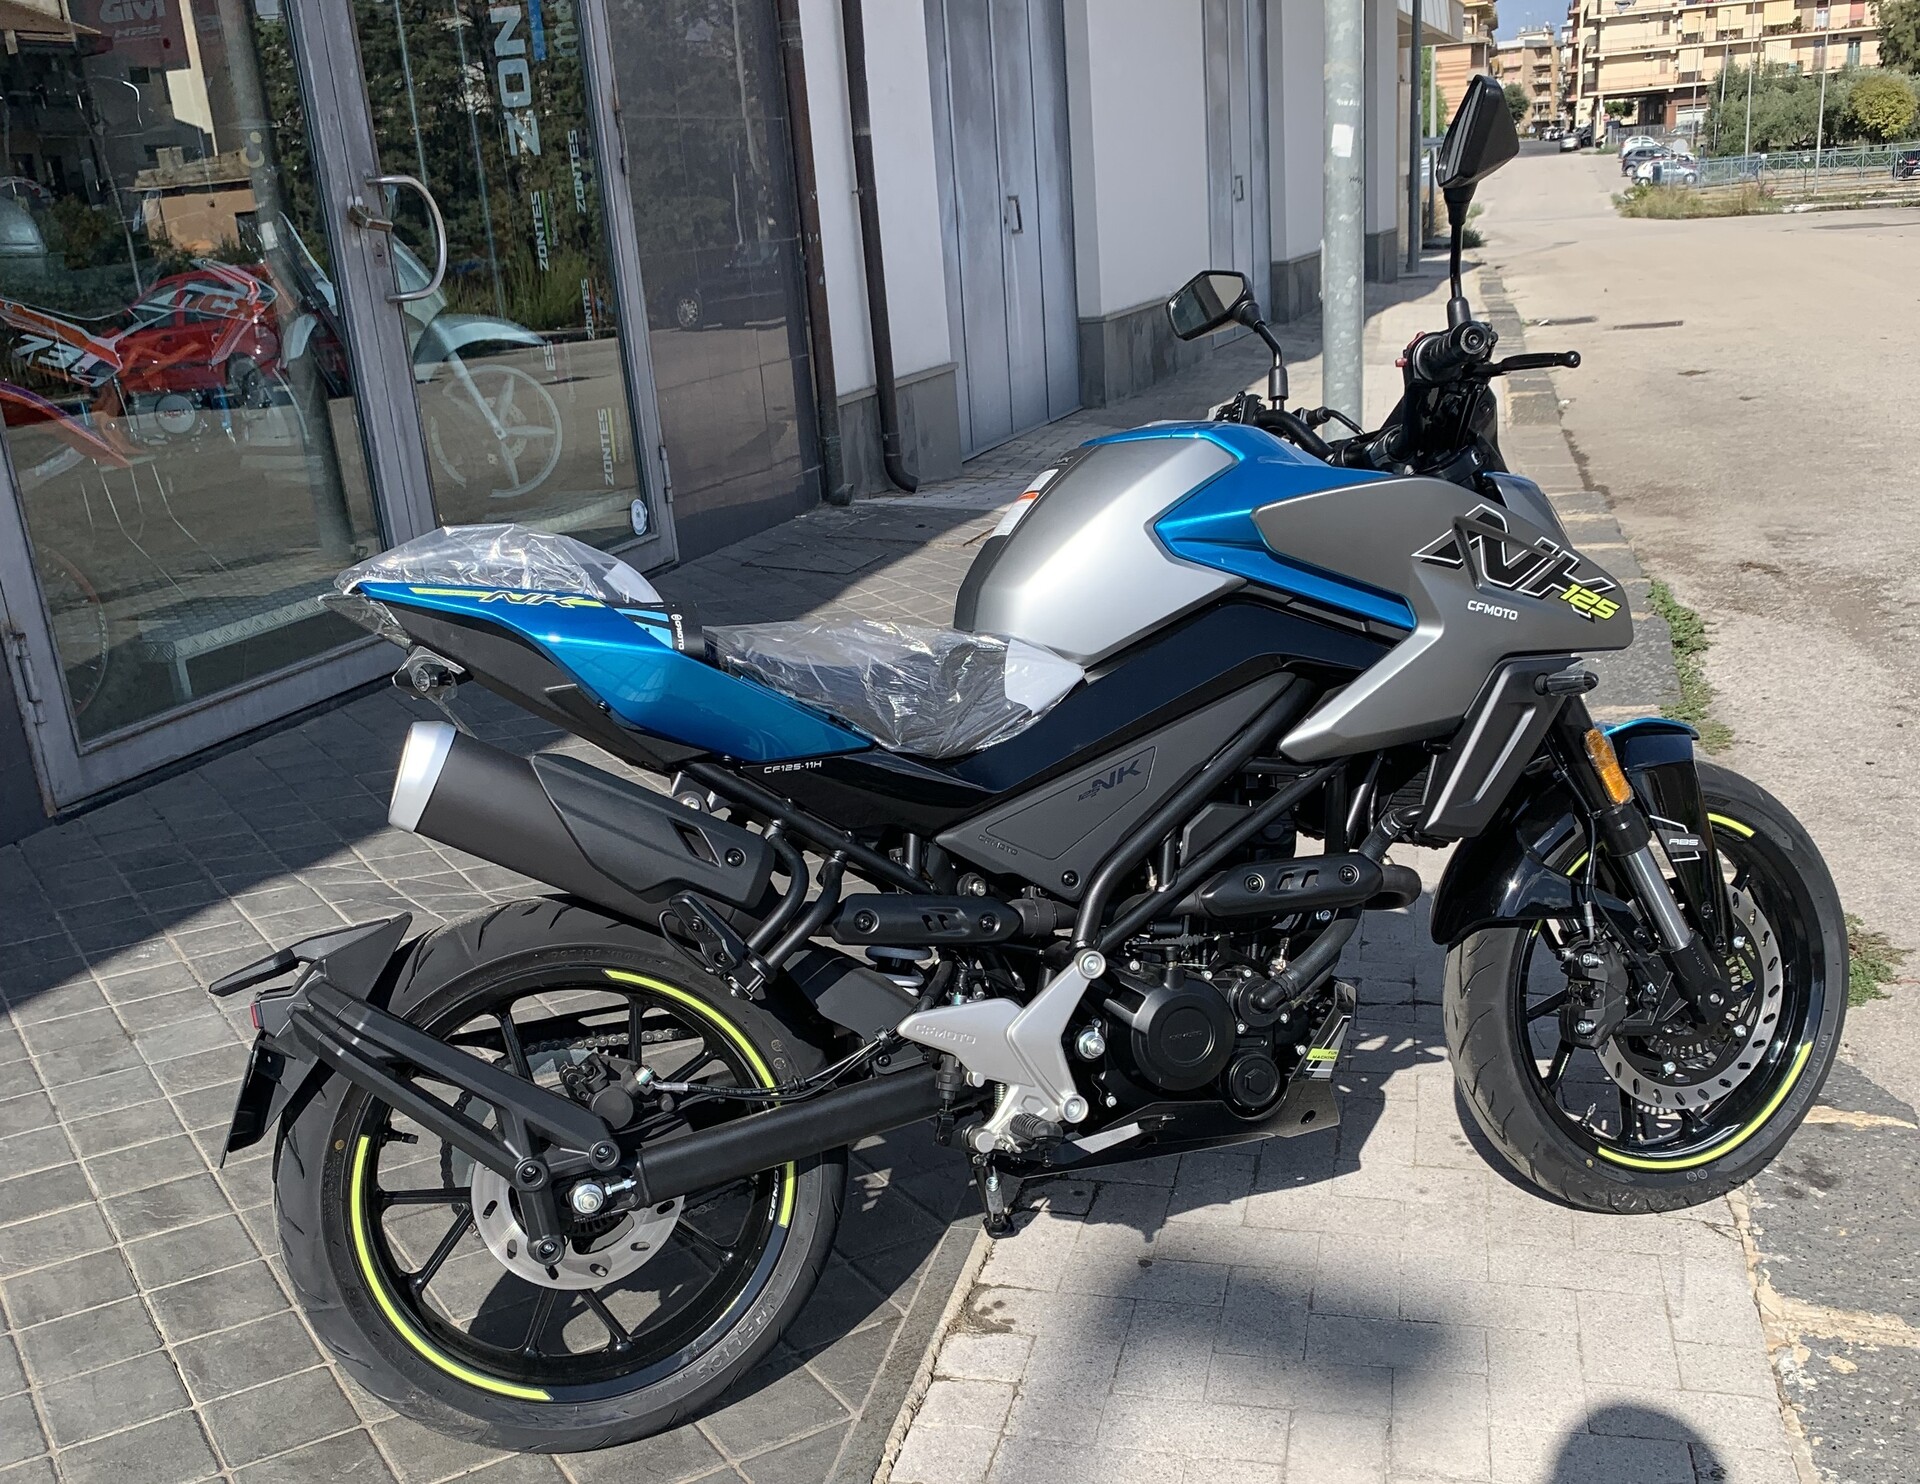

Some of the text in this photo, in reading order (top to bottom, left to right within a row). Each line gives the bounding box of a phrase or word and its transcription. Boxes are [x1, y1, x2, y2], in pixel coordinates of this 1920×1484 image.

[489, 0, 541, 156] ZON
[567, 129, 587, 213] ZONTES
[530, 190, 549, 271] ZONTES
[580, 278, 596, 340] ZONTES
[597, 408, 615, 486] ZONTES
[1467, 599, 1519, 621] CFMOTO
[1560, 583, 1621, 620] 125
[763, 760, 823, 774] CF125-11H
[1092, 758, 1142, 790] NK
[1668, 838, 1699, 846] ABS
[915, 1024, 976, 1045] CFMOTO
